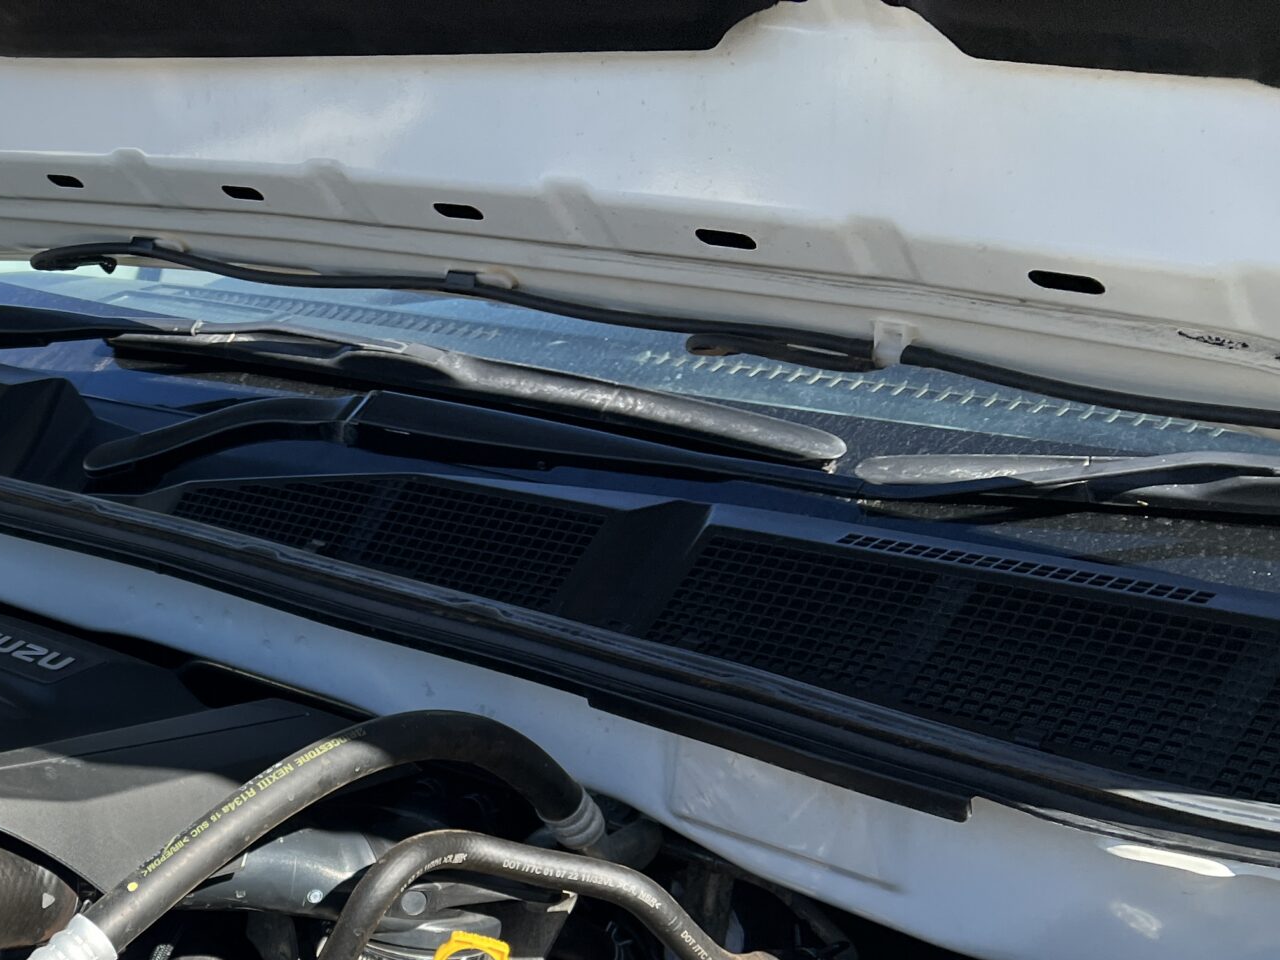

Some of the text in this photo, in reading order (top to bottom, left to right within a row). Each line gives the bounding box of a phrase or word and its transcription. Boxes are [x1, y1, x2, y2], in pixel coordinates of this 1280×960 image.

[502, 858, 520, 870] DOT
[543, 867, 553, 876] 01
[555, 869, 566, 878] 07
[567, 871, 578, 880] 22
[681, 930, 696, 946] DOT
